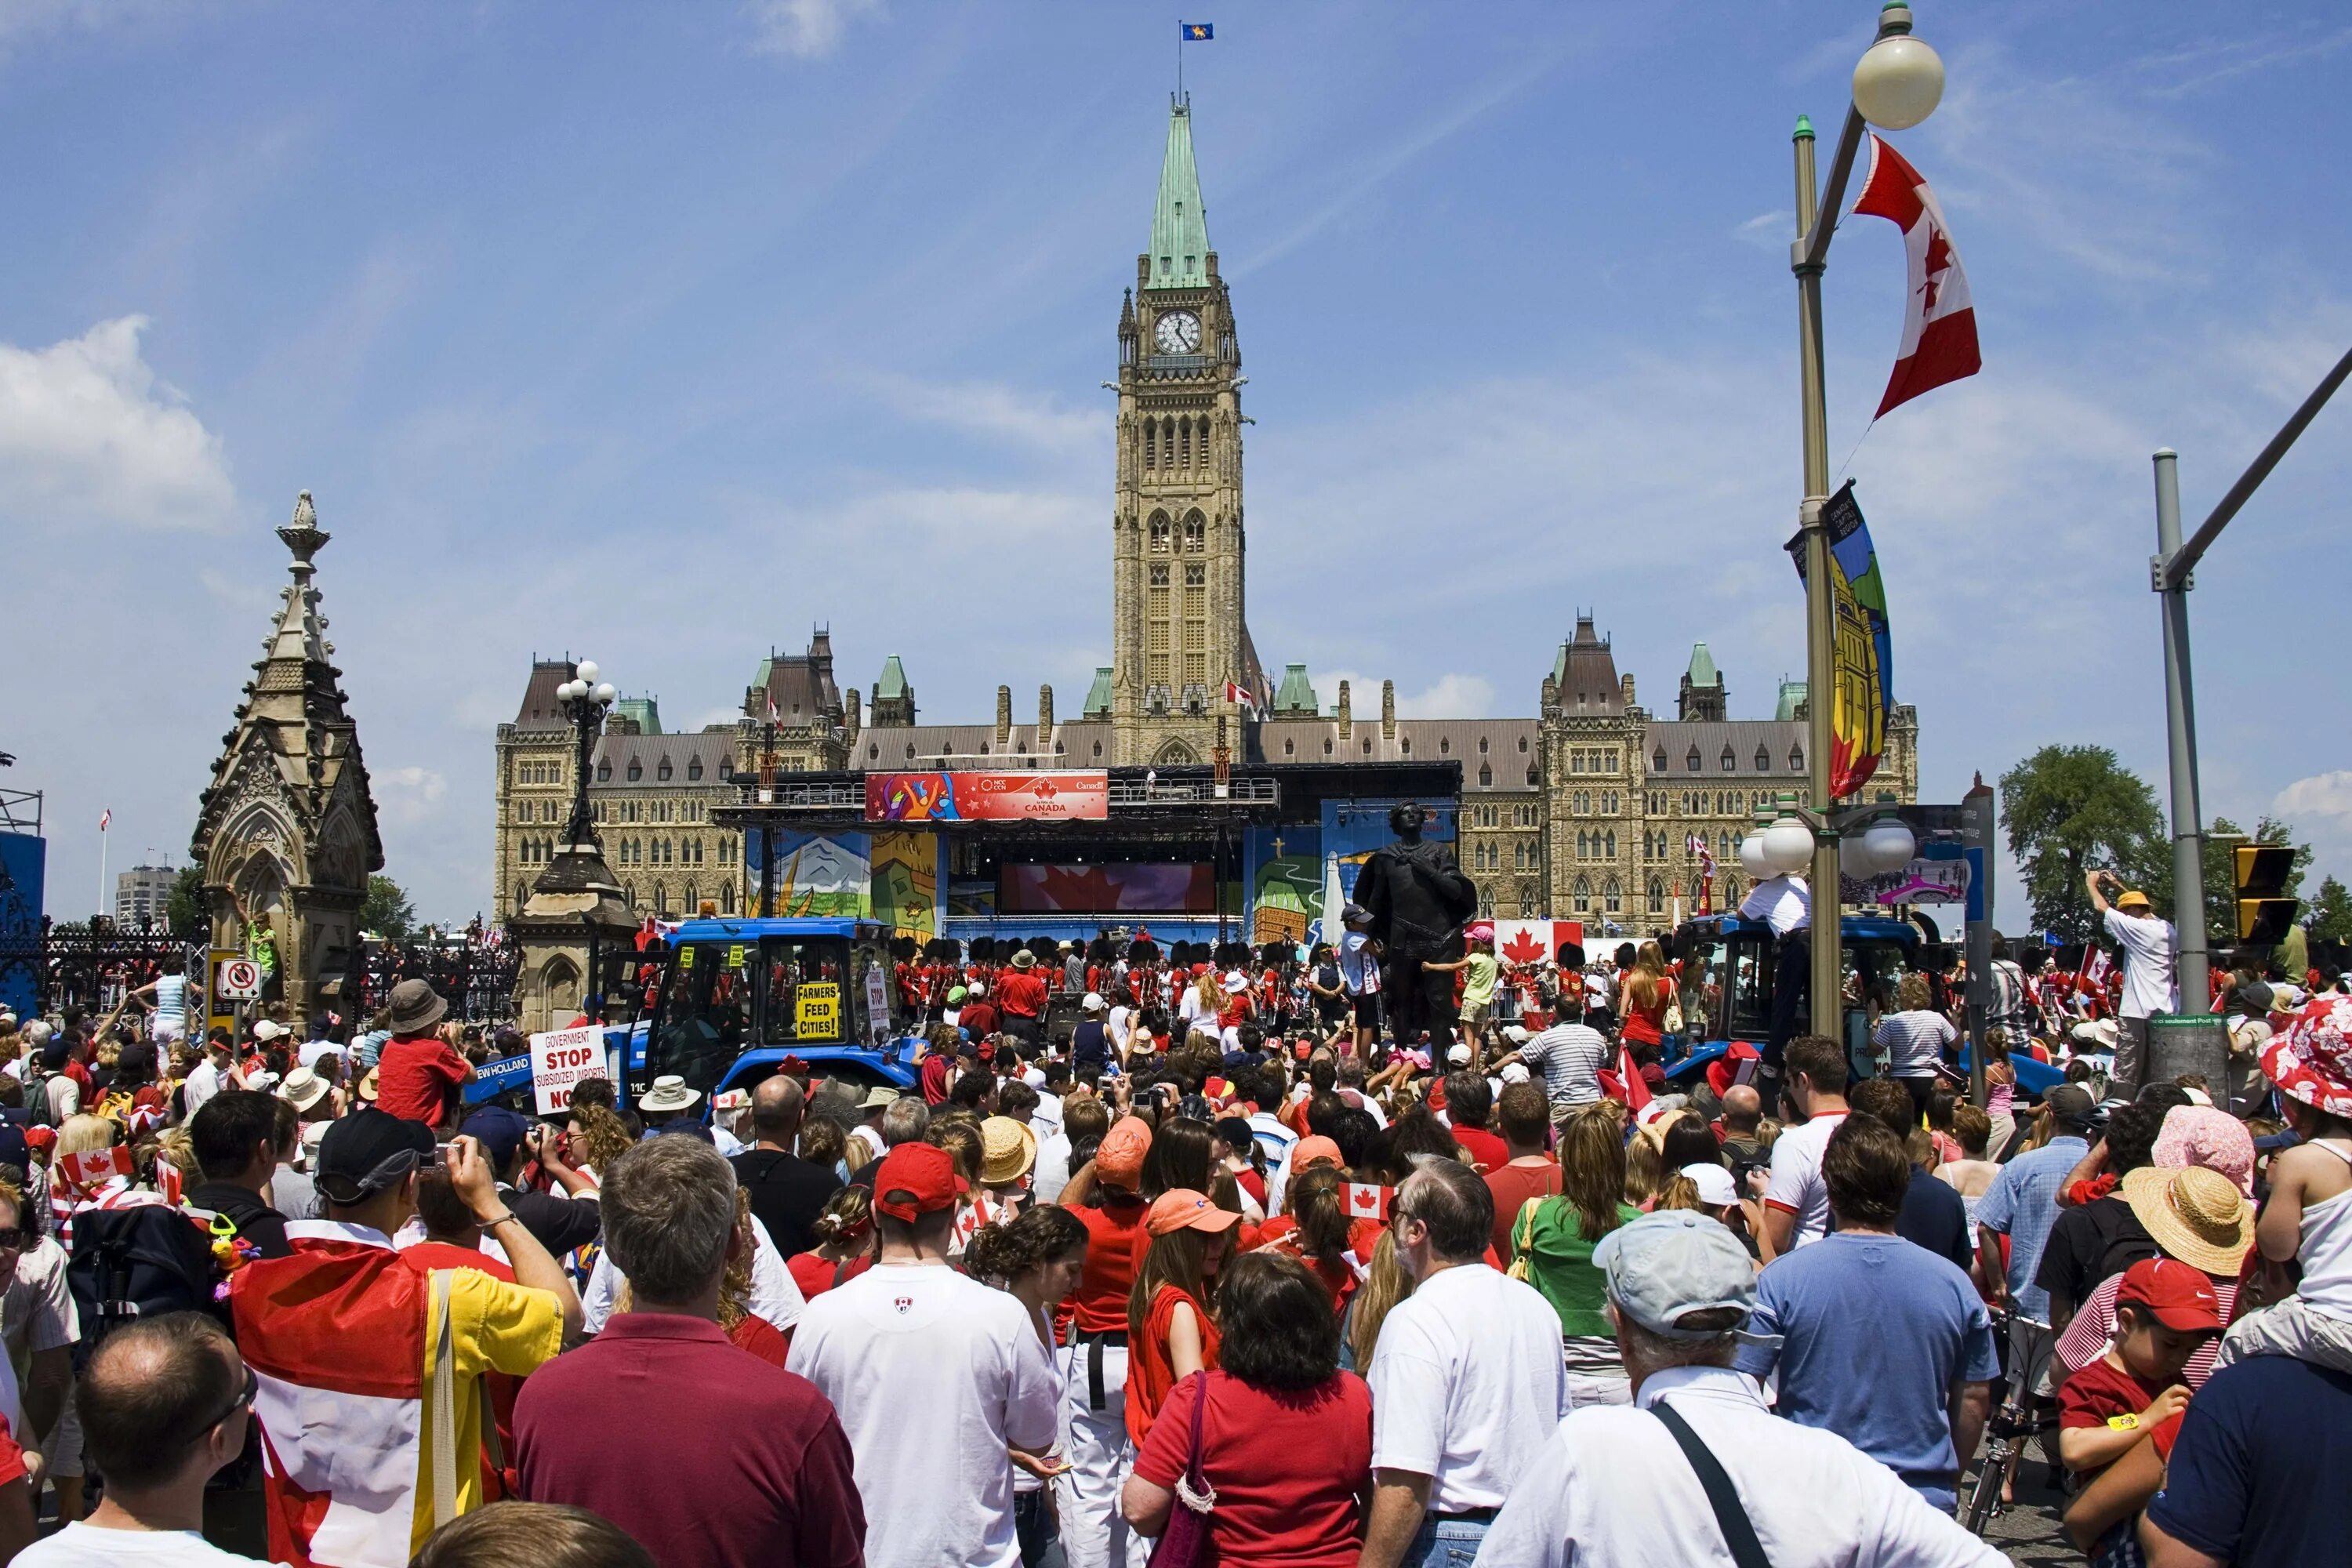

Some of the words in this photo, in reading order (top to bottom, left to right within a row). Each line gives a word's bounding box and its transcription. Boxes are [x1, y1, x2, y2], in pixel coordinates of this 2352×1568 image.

[1076, 781, 1104, 789] Canada
[797, 986, 836, 1001] FARMERS
[804, 1004, 830, 1018] FEED
[800, 1018, 836, 1035] CITIES!
[545, 1031, 590, 1048] GOVERNMENT
[546, 1047, 592, 1069] STOP
[477, 1067, 491, 1080] EW
[491, 1058, 528, 1076] HOLLAND
[577, 1066, 606, 1081] IMPORTS
[550, 1089, 572, 1109] NO
